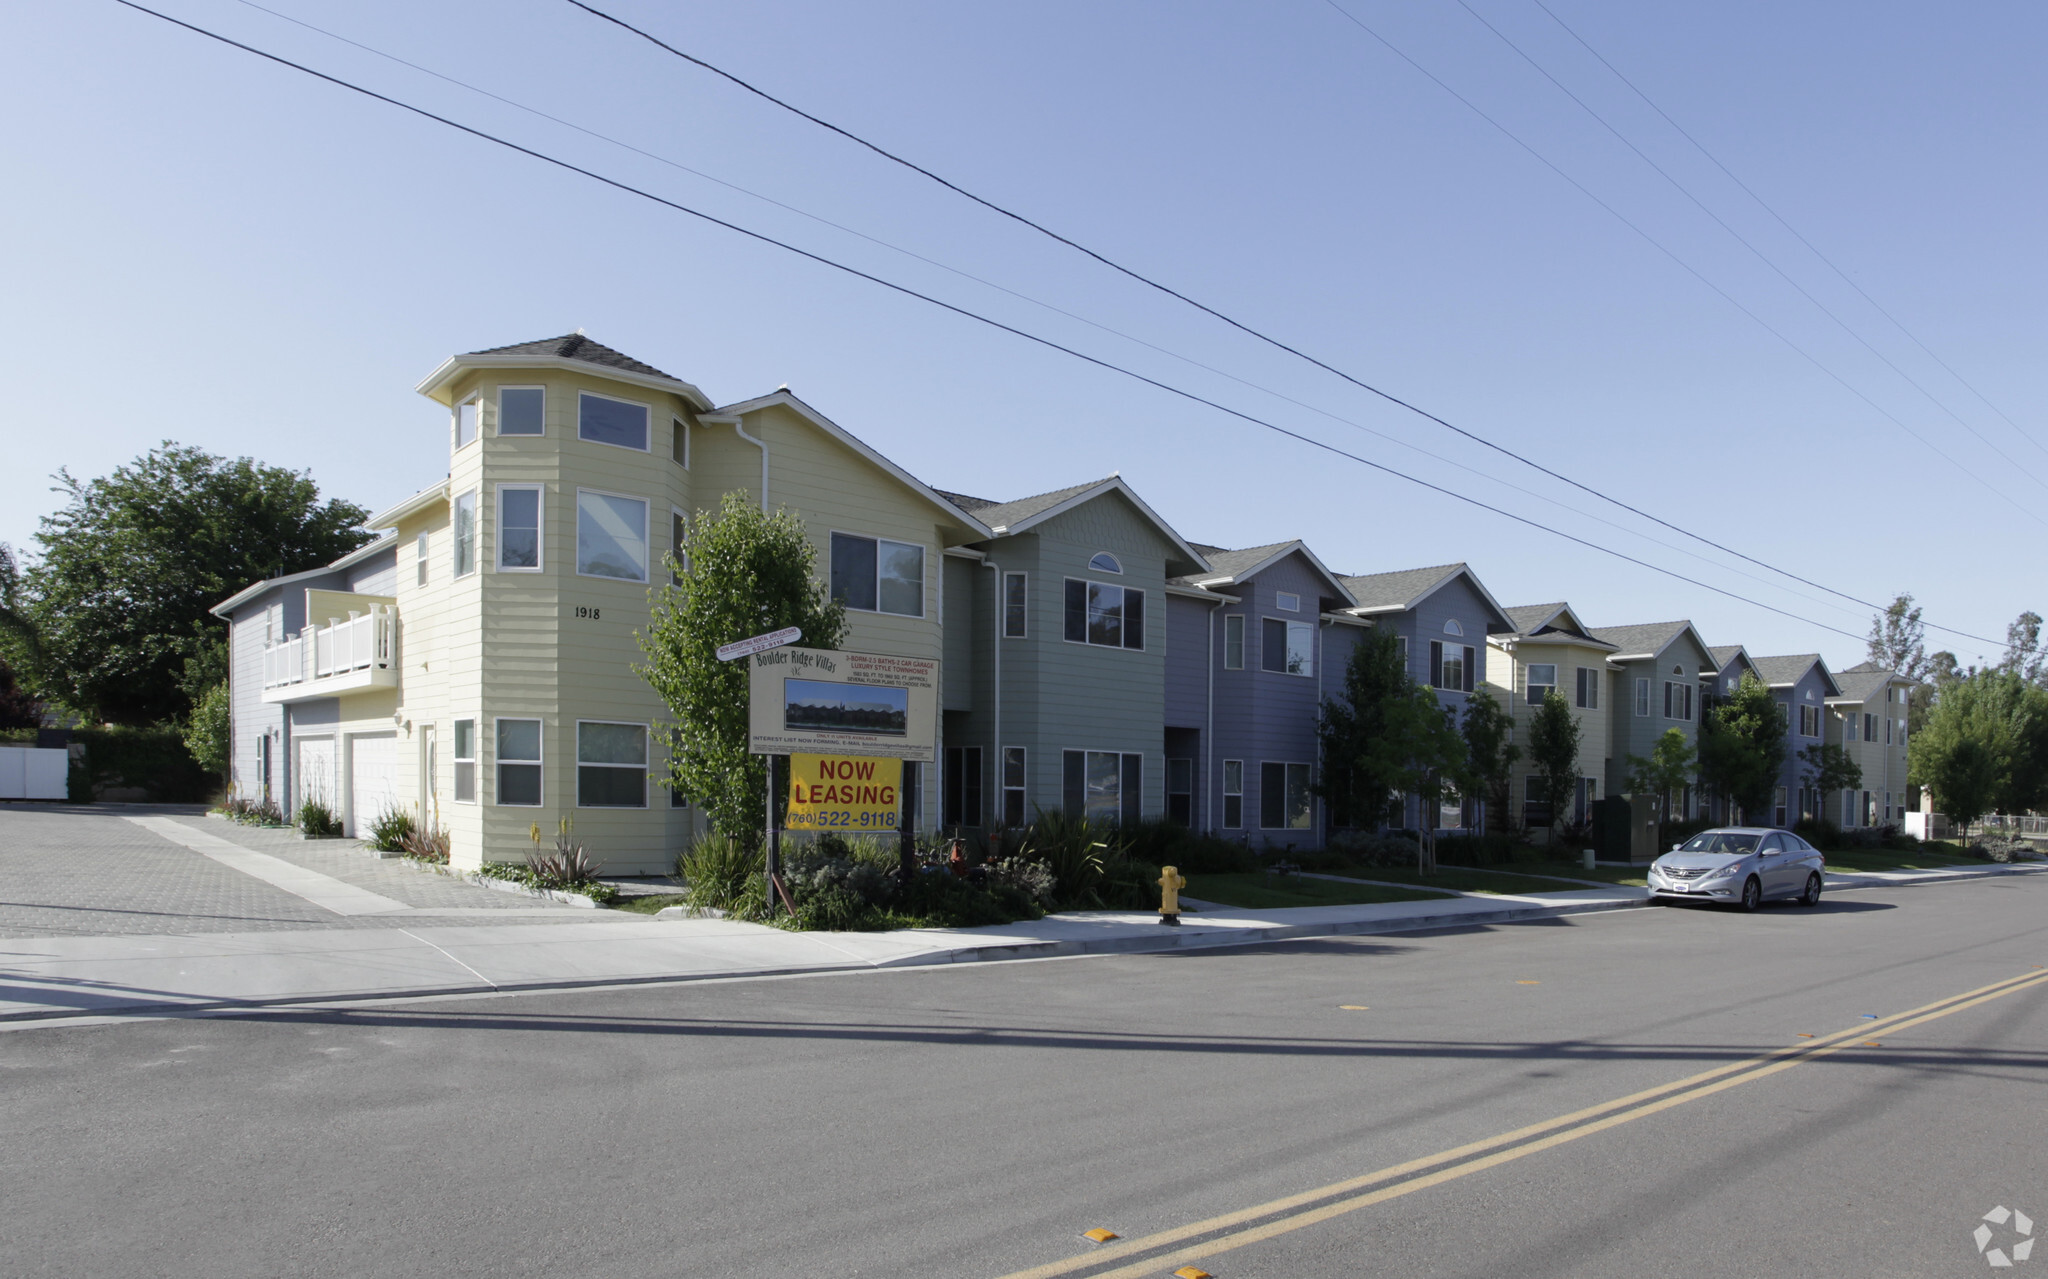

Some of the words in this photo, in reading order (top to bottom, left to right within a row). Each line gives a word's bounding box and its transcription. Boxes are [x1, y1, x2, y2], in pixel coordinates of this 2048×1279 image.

[576, 606, 600, 620] 1918
[730, 640, 752, 650] ACCEPTING
[753, 636, 768, 644] RENTAL
[770, 628, 797, 640] APPLICATIONS
[752, 640, 784, 652] 522-9118
[756, 651, 788, 667] Boulder
[791, 650, 814, 668] Ridge
[816, 654, 836, 673] Villas
[913, 661, 934, 669] GARAGE
[893, 666, 928, 675] TOWNHOMES
[820, 760, 875, 780] NOW
[795, 784, 895, 805] LEASING
[788, 812, 817, 824] (760)
[818, 811, 895, 826] 522-9118
